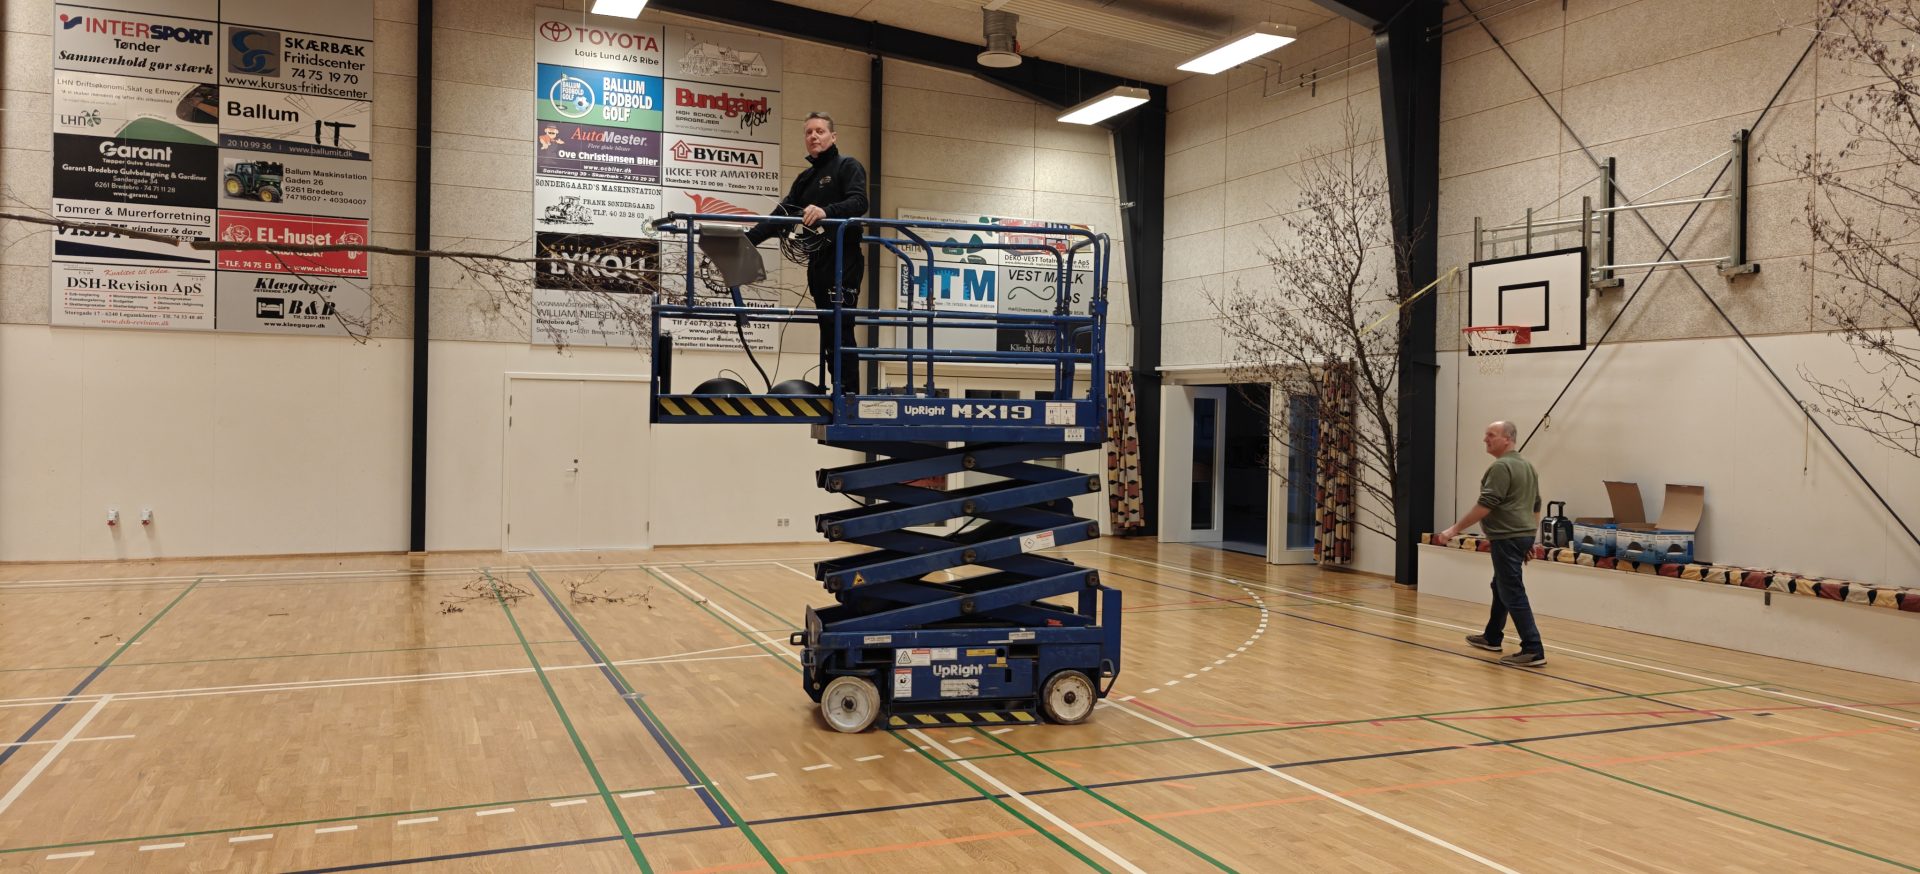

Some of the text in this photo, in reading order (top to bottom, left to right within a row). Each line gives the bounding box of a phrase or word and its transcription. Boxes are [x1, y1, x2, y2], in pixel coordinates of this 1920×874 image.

[86, 16, 213, 46] INTERSPORT
[114, 38, 161, 53] Tønder
[285, 37, 365, 57] SKÆRBÆK
[575, 27, 659, 53] TOYOTA
[58, 50, 214, 75] Sammenhold gør stærk
[284, 51, 365, 71] Fritidscenter
[574, 48, 659, 66] Louis Lund A/S Ribe
[57, 78, 74, 87] LHN
[291, 68, 359, 85] 74 75 19 70
[562, 81, 581, 89] BALLUM
[603, 76, 646, 95] BALLUM
[562, 93, 575, 101] GOLF
[603, 91, 653, 110] FODBOLD
[227, 100, 299, 122] Ballum
[603, 105, 631, 122] GOLF
[315, 119, 357, 147] IT
[99, 140, 173, 162] Garant
[227, 139, 272, 150] 20 10 99 36
[289, 145, 353, 158] www.ballumit.dk
[558, 149, 659, 166] Ove Christiansen Biler
[694, 147, 759, 166] BYGMA
[62, 163, 86, 172] Garant
[285, 167, 368, 180] Ballum Maskinstation
[665, 168, 779, 181] IKKE FOR AMATØRER
[94, 181, 110, 189] 6261
[285, 176, 311, 185] Gaden
[112, 190, 158, 199] www.garant.nu
[285, 185, 344, 196] 6261 Bredebro
[601, 184, 662, 196] MASKINSTATION
[329, 197, 367, 205] 40304007
[56, 203, 211, 224] Tømrer & Murerforretning
[131, 224, 169, 235] vinduer
[181, 227, 203, 236] døre
[256, 226, 332, 246] EL-huset
[224, 260, 241, 268] TLF.
[242, 261, 252, 269] 74
[253, 261, 262, 270] 75
[1009, 269, 1042, 282] VEST
[66, 276, 168, 292] DSH-Revision
[172, 282, 202, 296] ApS
[254, 277, 337, 295] Klægager
[536, 309, 576, 318] WILLIAM
[566, 319, 579, 327] ApS
[1010, 343, 1031, 352] Klindt
[904, 405, 945, 417] UpRight
[951, 403, 1032, 420] MX19
[932, 663, 984, 679] UpRight
